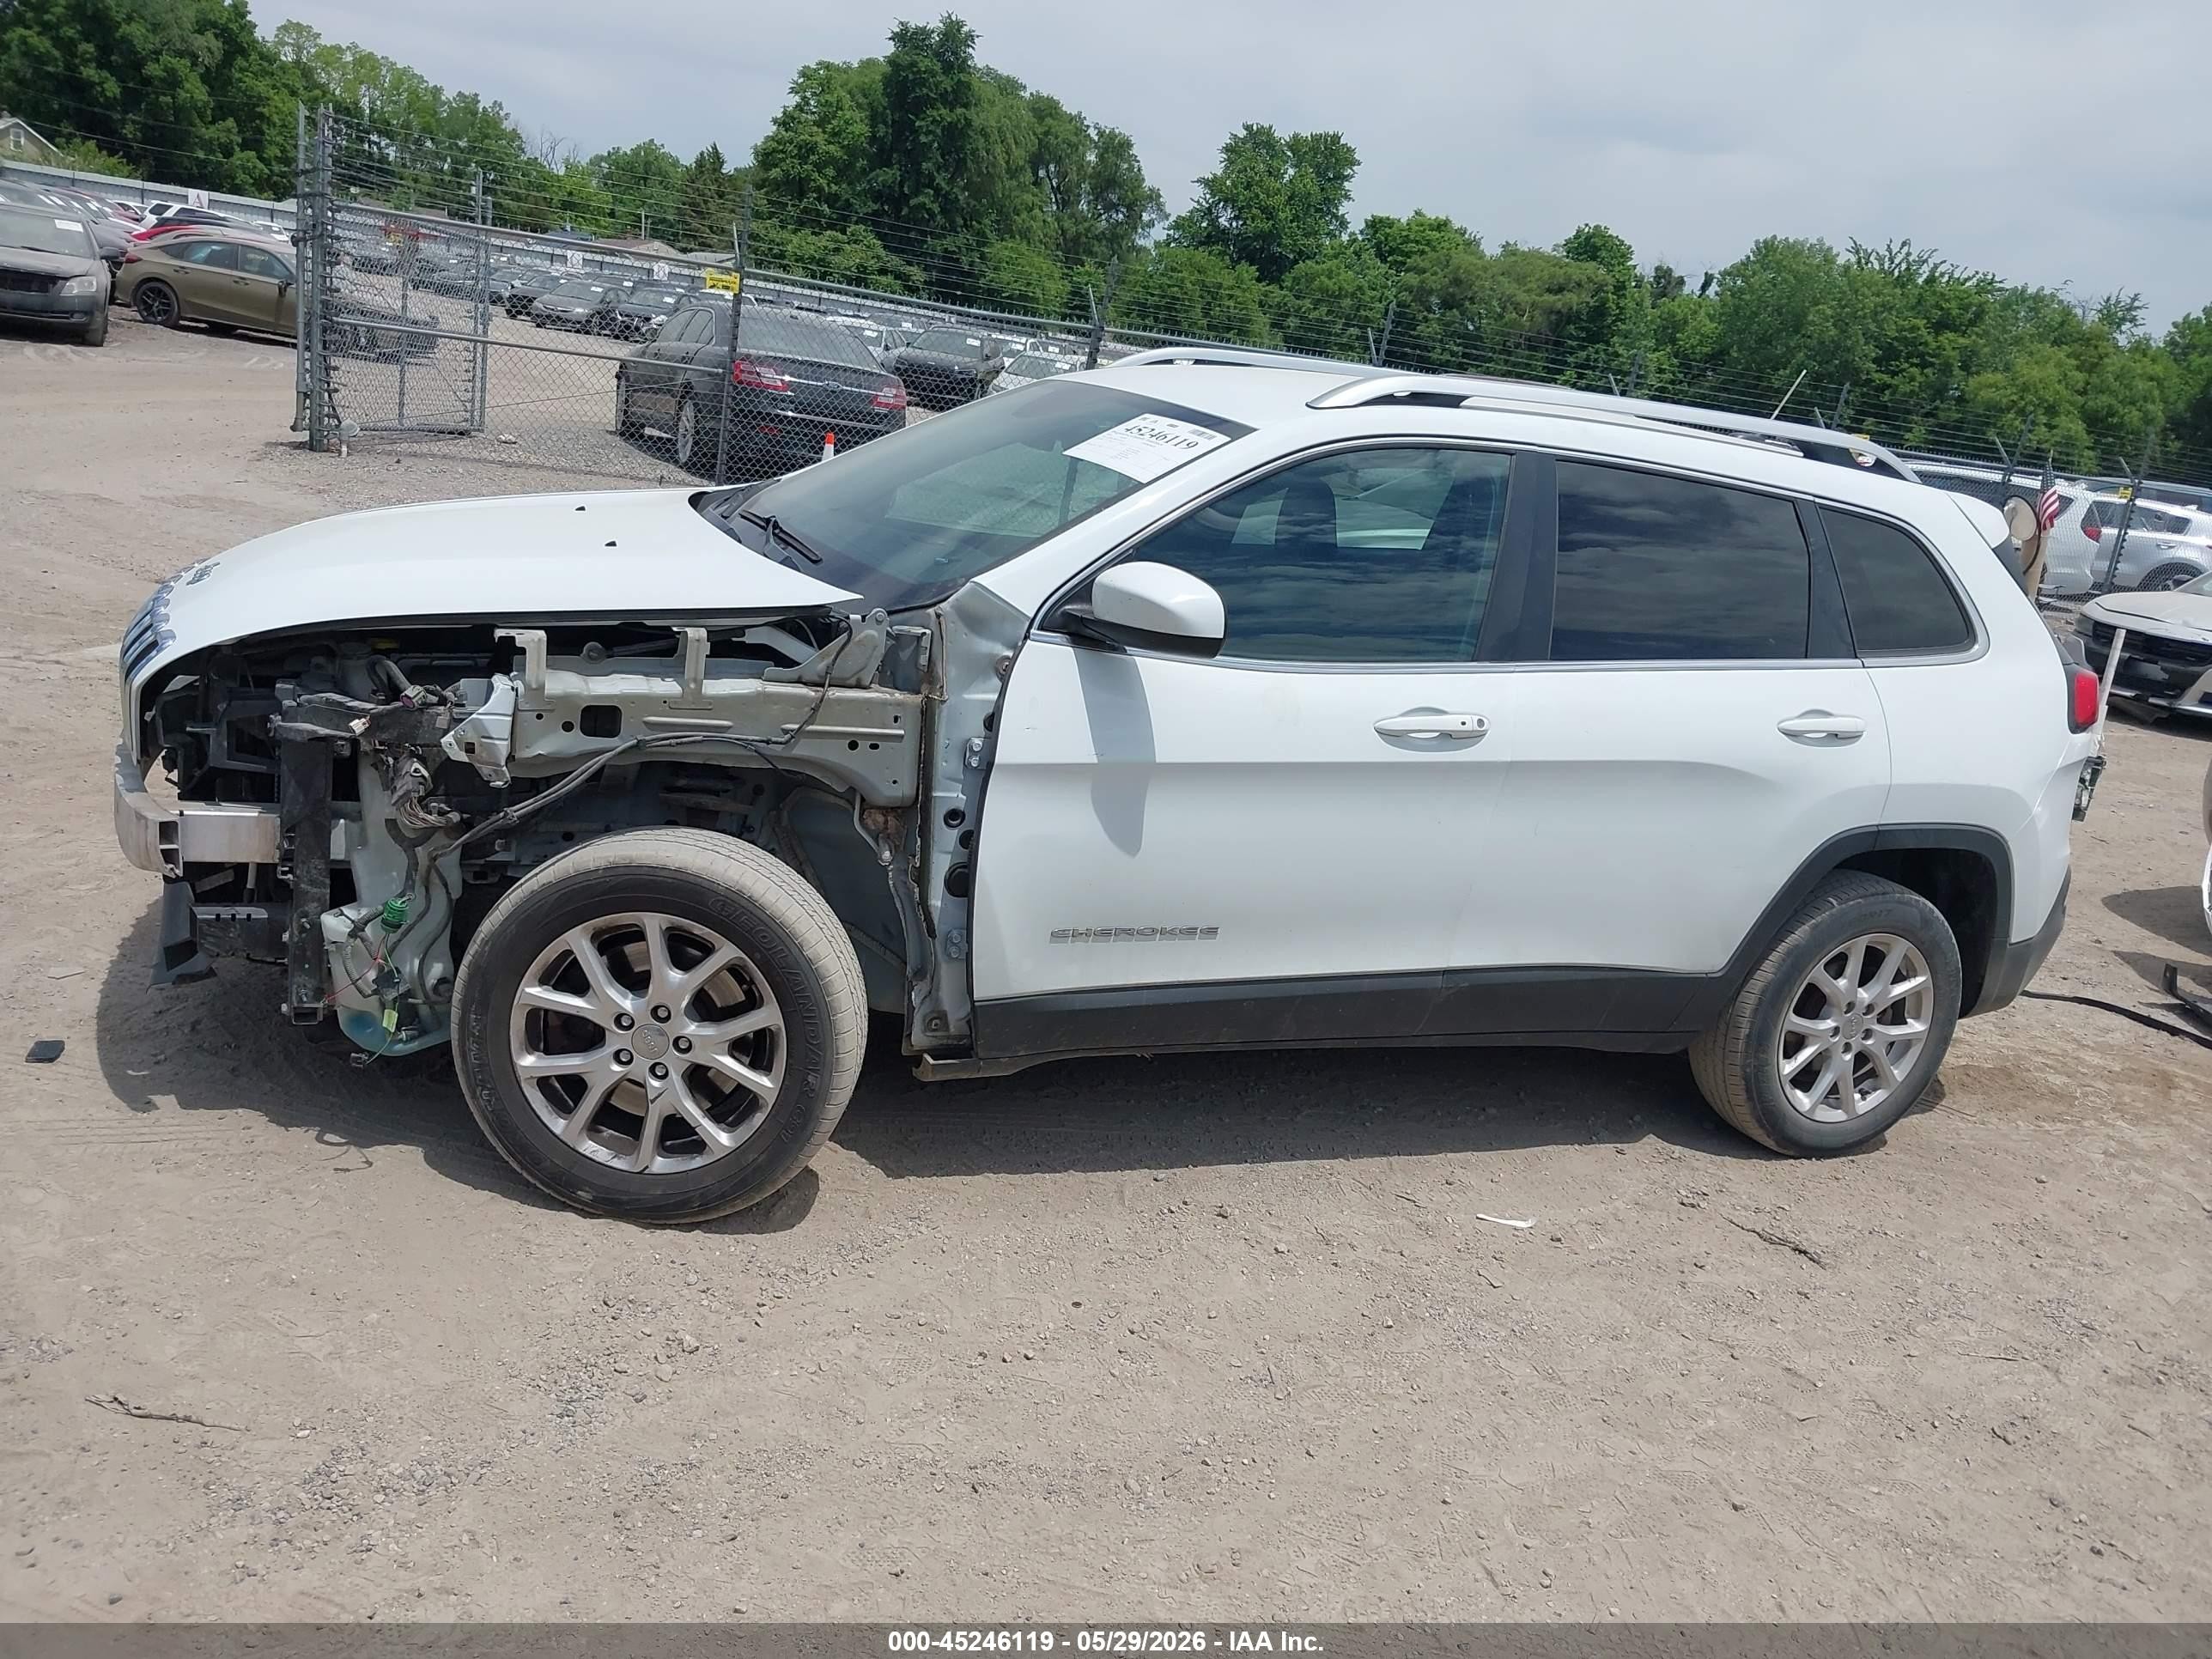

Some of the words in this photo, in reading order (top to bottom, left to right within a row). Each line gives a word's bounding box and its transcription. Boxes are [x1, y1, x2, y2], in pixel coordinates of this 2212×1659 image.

[1123, 424, 1200, 450] 45246119
[1050, 926, 1220, 941] CHEROKEE
[708, 896, 824, 1098] GEOLANDAR
